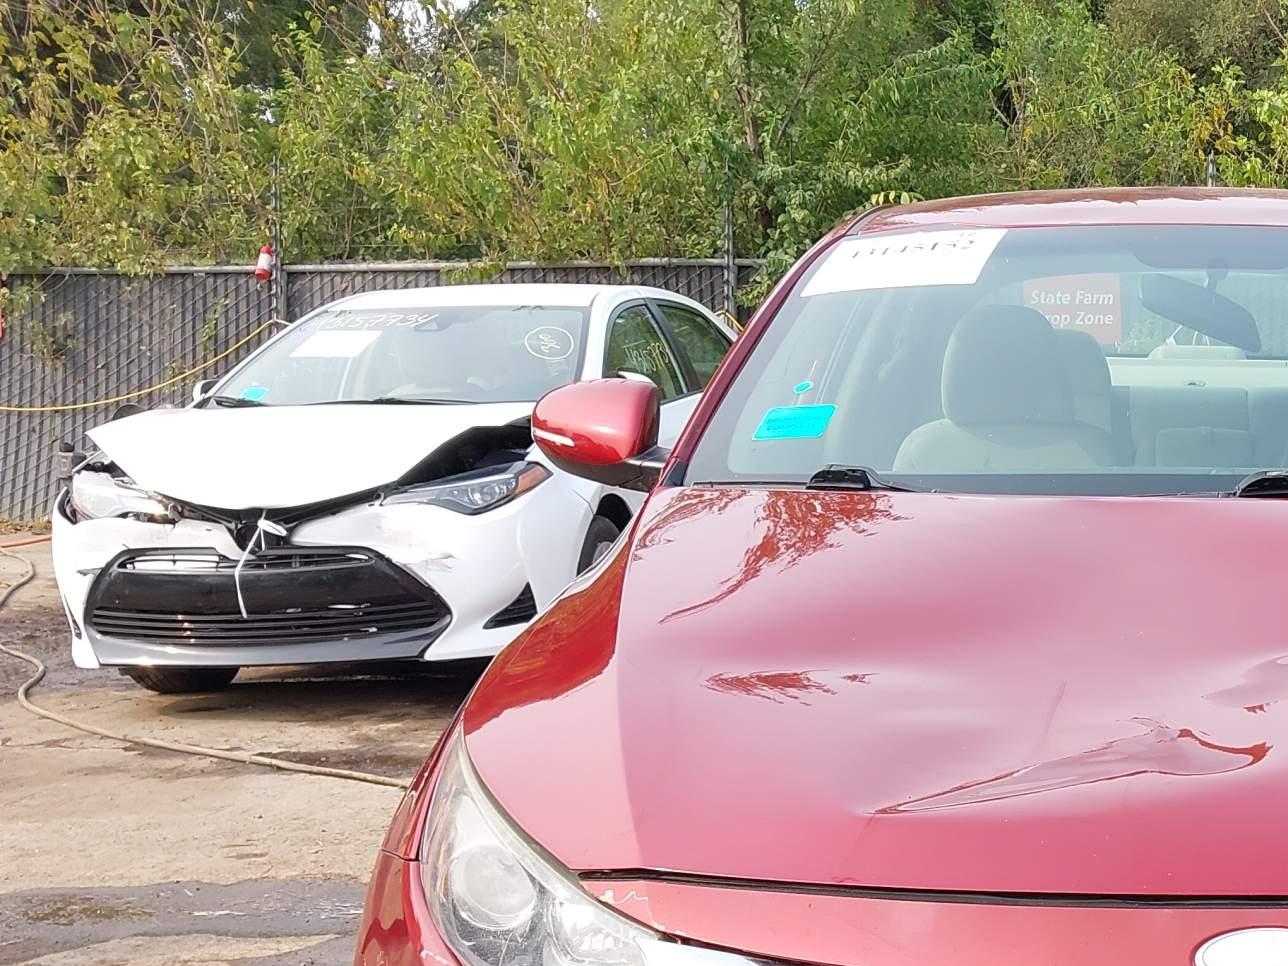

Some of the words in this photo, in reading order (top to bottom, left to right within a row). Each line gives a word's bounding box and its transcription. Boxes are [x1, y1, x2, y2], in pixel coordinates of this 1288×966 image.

[1030, 289, 1072, 305] State
[1075, 289, 1114, 305] Farm
[1074, 311, 1114, 326] Zone
